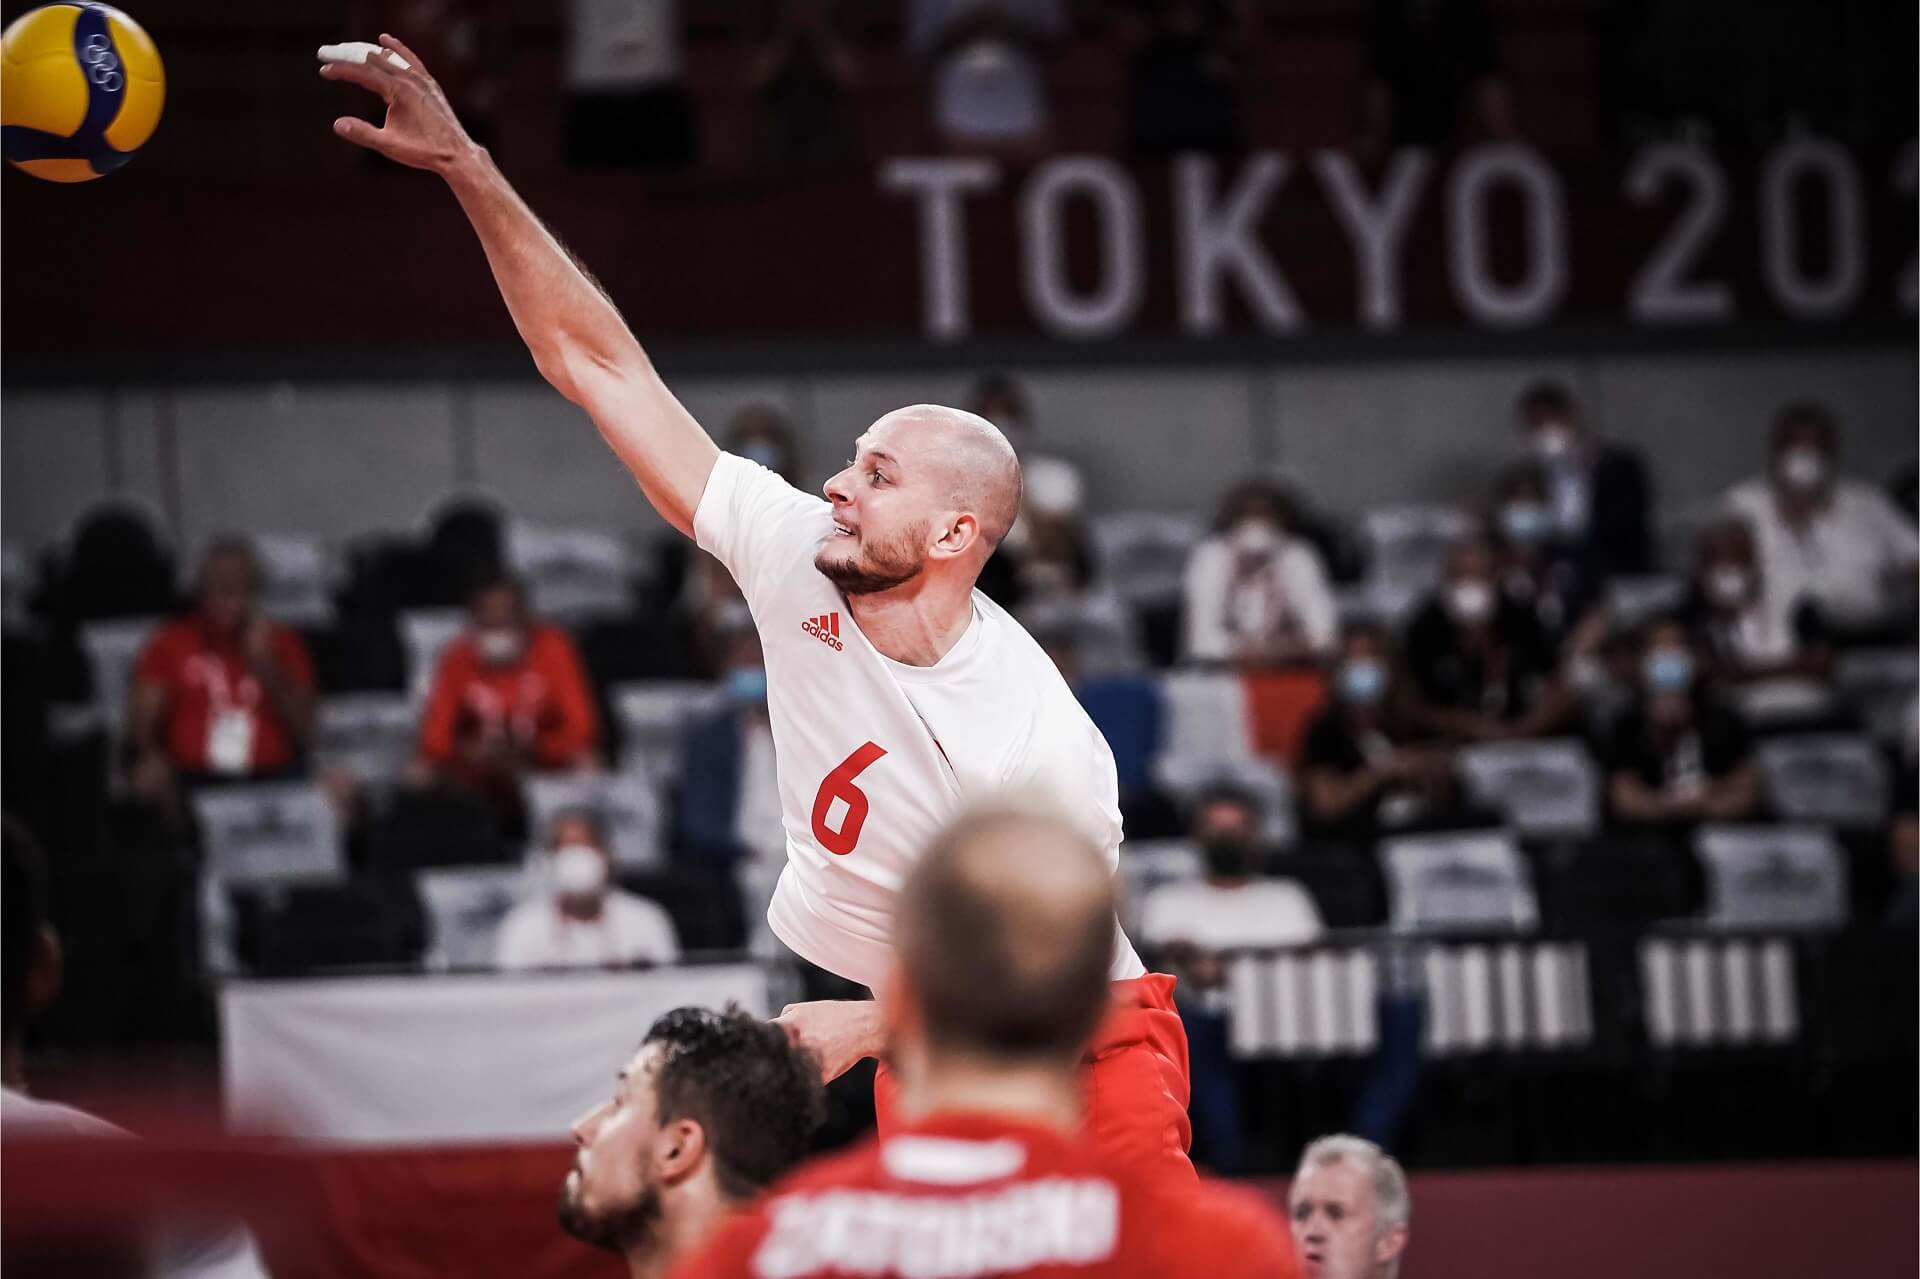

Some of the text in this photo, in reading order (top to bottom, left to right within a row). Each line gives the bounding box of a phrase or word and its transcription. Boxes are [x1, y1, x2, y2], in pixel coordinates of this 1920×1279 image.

[881, 139, 1918, 339] TOKYO 20
[801, 620, 844, 652] adidas
[811, 741, 888, 856] 6
